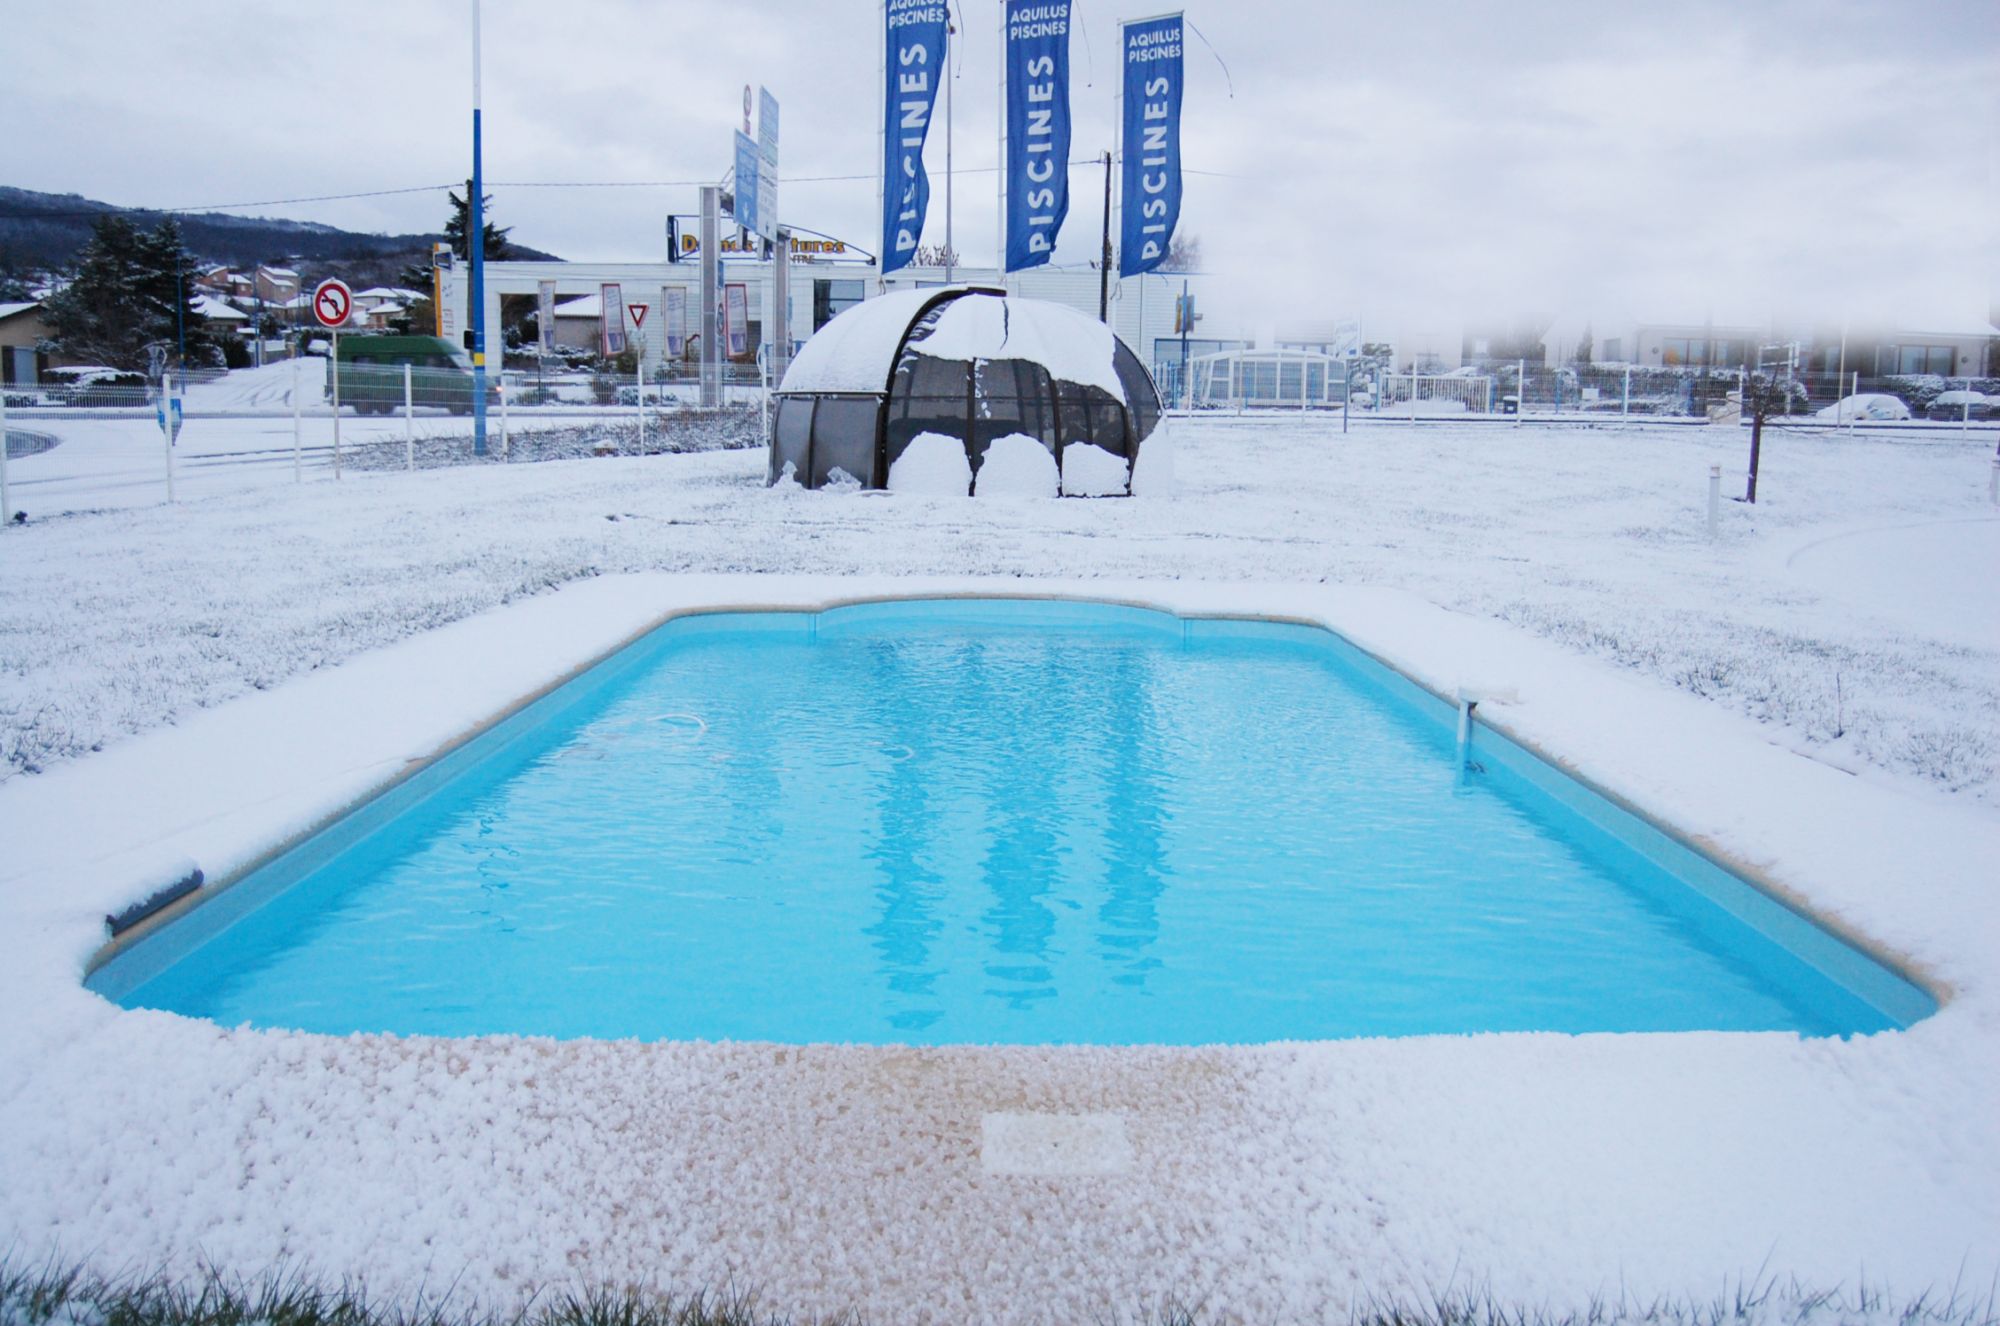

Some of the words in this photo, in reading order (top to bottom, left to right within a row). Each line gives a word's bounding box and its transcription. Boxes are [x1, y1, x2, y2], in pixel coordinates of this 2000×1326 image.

[888, 7, 945, 30] PISCINES
[1010, 4, 1068, 24] AQUILUS
[1010, 21, 1067, 40] PISCINES
[1129, 28, 1181, 48] AQUILUS
[1129, 44, 1181, 63] PISCINES
[1027, 55, 1054, 254] PISCINES
[1141, 76, 1169, 261] PISCINES
